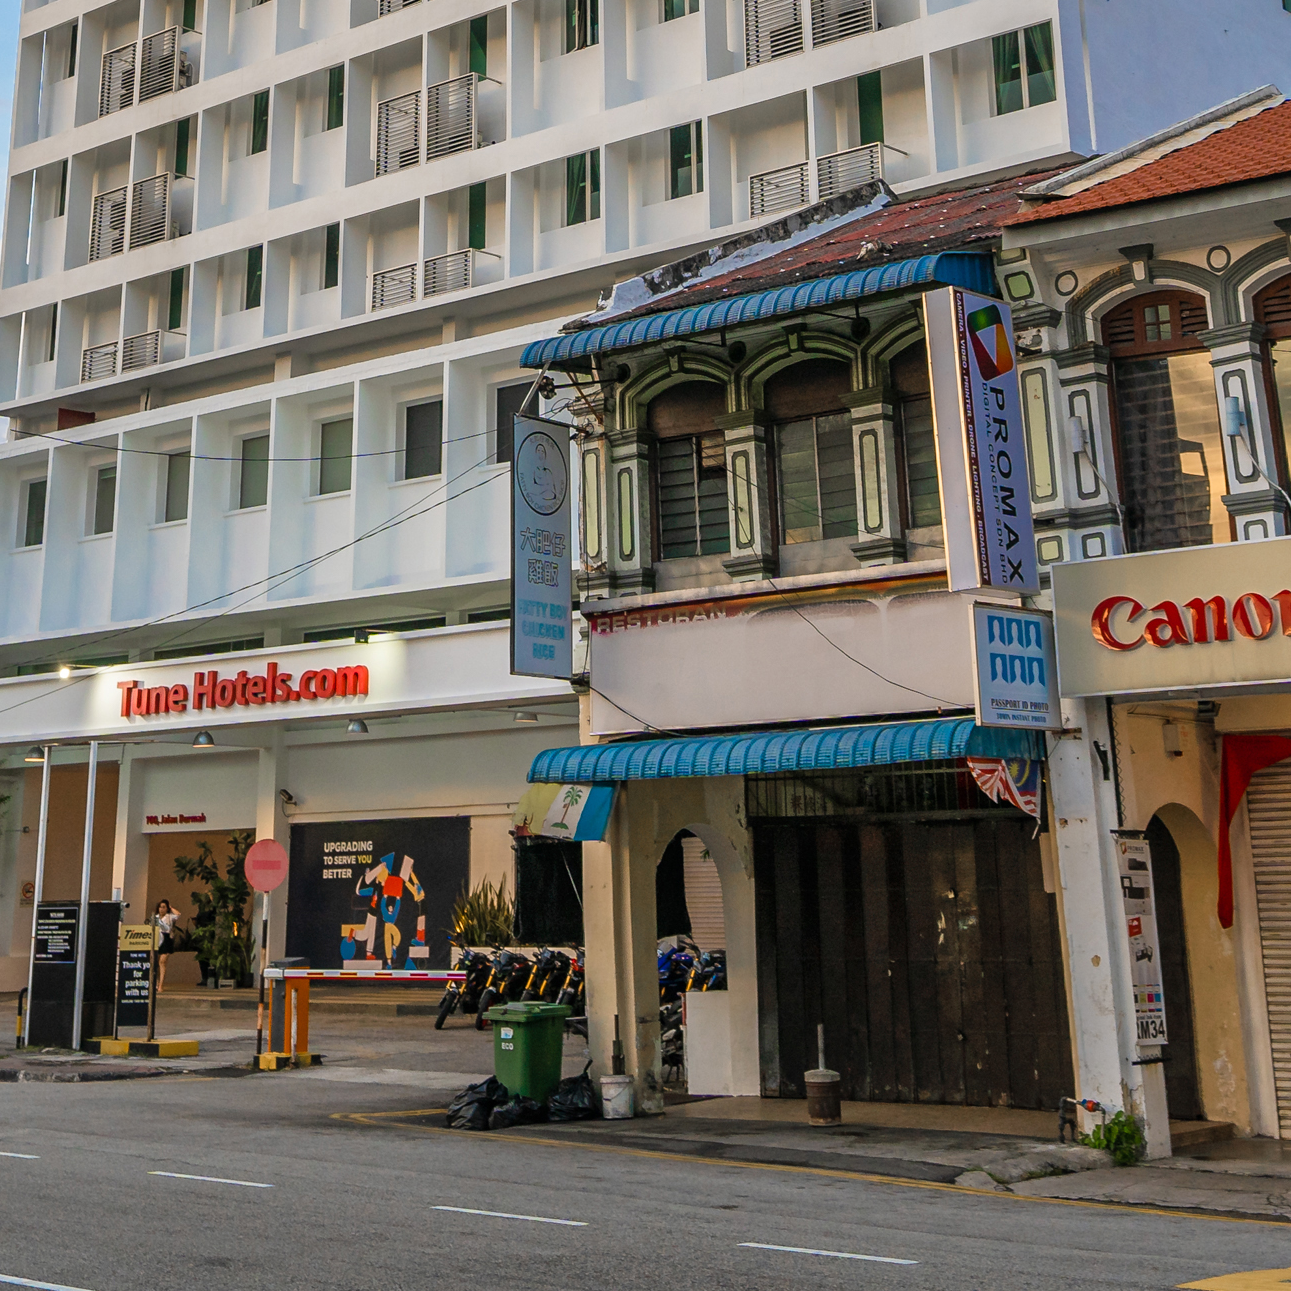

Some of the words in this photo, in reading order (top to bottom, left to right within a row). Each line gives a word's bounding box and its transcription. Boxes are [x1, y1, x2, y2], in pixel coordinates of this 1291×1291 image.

[960, 339, 968, 368] VIDEO
[963, 376, 972, 418] PRINTER
[981, 382, 994, 438] DIGITAL
[968, 424, 976, 455] DRONE
[972, 465, 982, 513] LIGHTING
[987, 443, 1001, 513] CONCEPT
[990, 386, 1025, 584] PROMAX
[520, 527, 566, 557] 大肥仔
[995, 518, 1004, 547] SDN
[977, 520, 989, 581] BROADCAST
[999, 553, 1008, 584] BHD
[518, 598, 548, 618] FATTY
[549, 603, 569, 621] BOY
[521, 620, 565, 641] CHICKEN
[532, 642, 556, 660] RICE
[117, 679, 188, 717] Tune
[192, 661, 369, 710] Hotels.com
[990, 698, 1021, 709] PASSPORT
[1021, 700, 1029, 709] ID
[1029, 701, 1049, 711] PHOTO
[1011, 714, 1031, 722] INSTANT
[1031, 715, 1047, 723] PHOTO
[323, 841, 373, 853] UPGRADING
[323, 856, 333, 865] TO
[333, 855, 357, 865] SERVE
[356, 854, 373, 864] YOU
[322, 868, 352, 879] BETTER
[124, 930, 152, 940] Times
[122, 961, 142, 969] Thank
[142, 962, 151, 970] yo
[133, 970, 143, 978] for
[125, 979, 149, 988] parking
[501, 1042, 514, 1051] ECO
